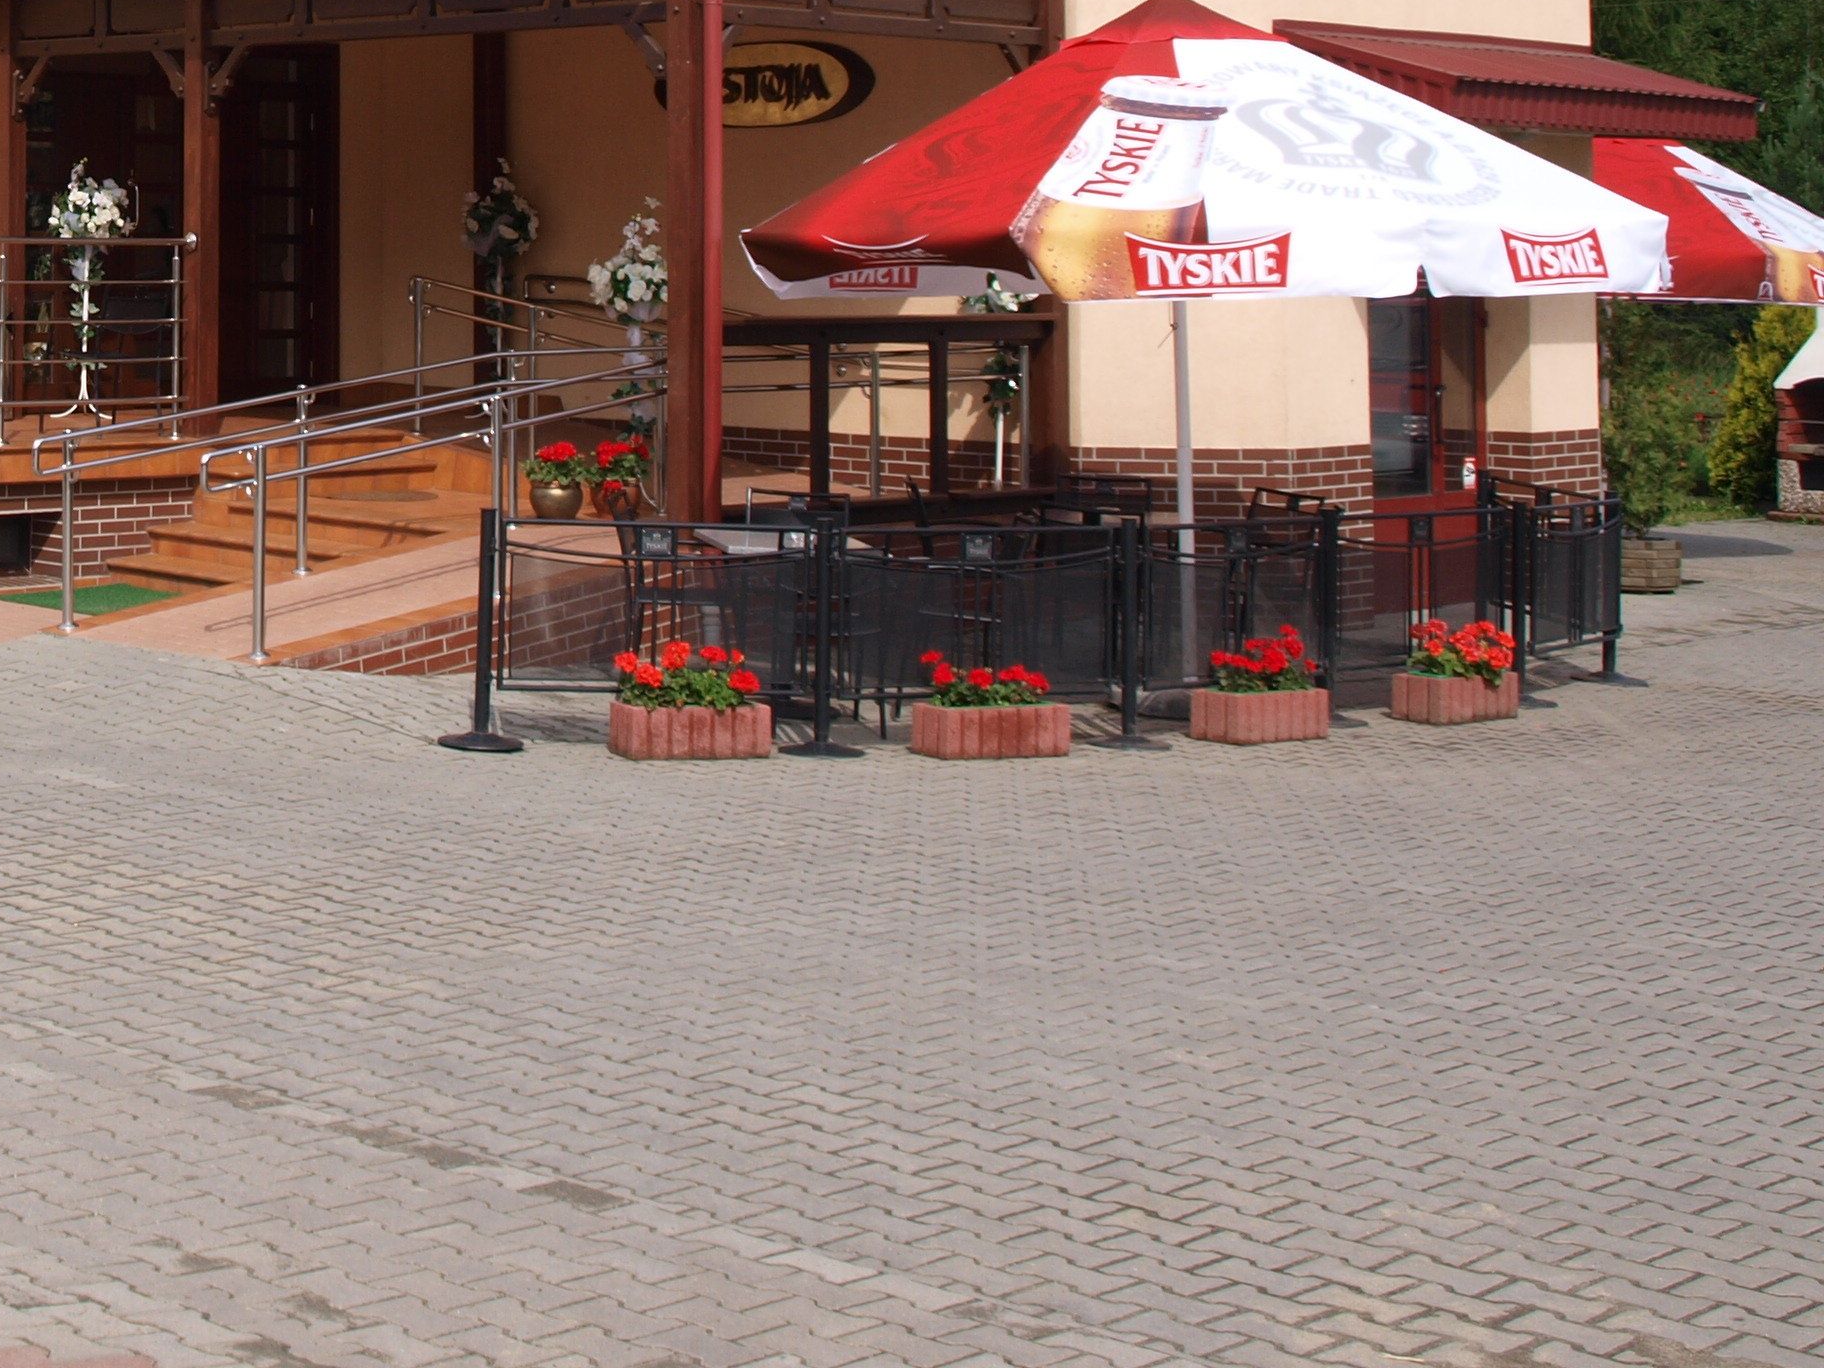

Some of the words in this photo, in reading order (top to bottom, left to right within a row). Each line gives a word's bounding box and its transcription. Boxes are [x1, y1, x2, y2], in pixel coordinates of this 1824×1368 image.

[722, 62, 832, 112] STOJA
[1072, 118, 1164, 198] TYSKIE
[1138, 243, 1283, 287] TYSKIE
[1509, 236, 1606, 278] TYSKIE
